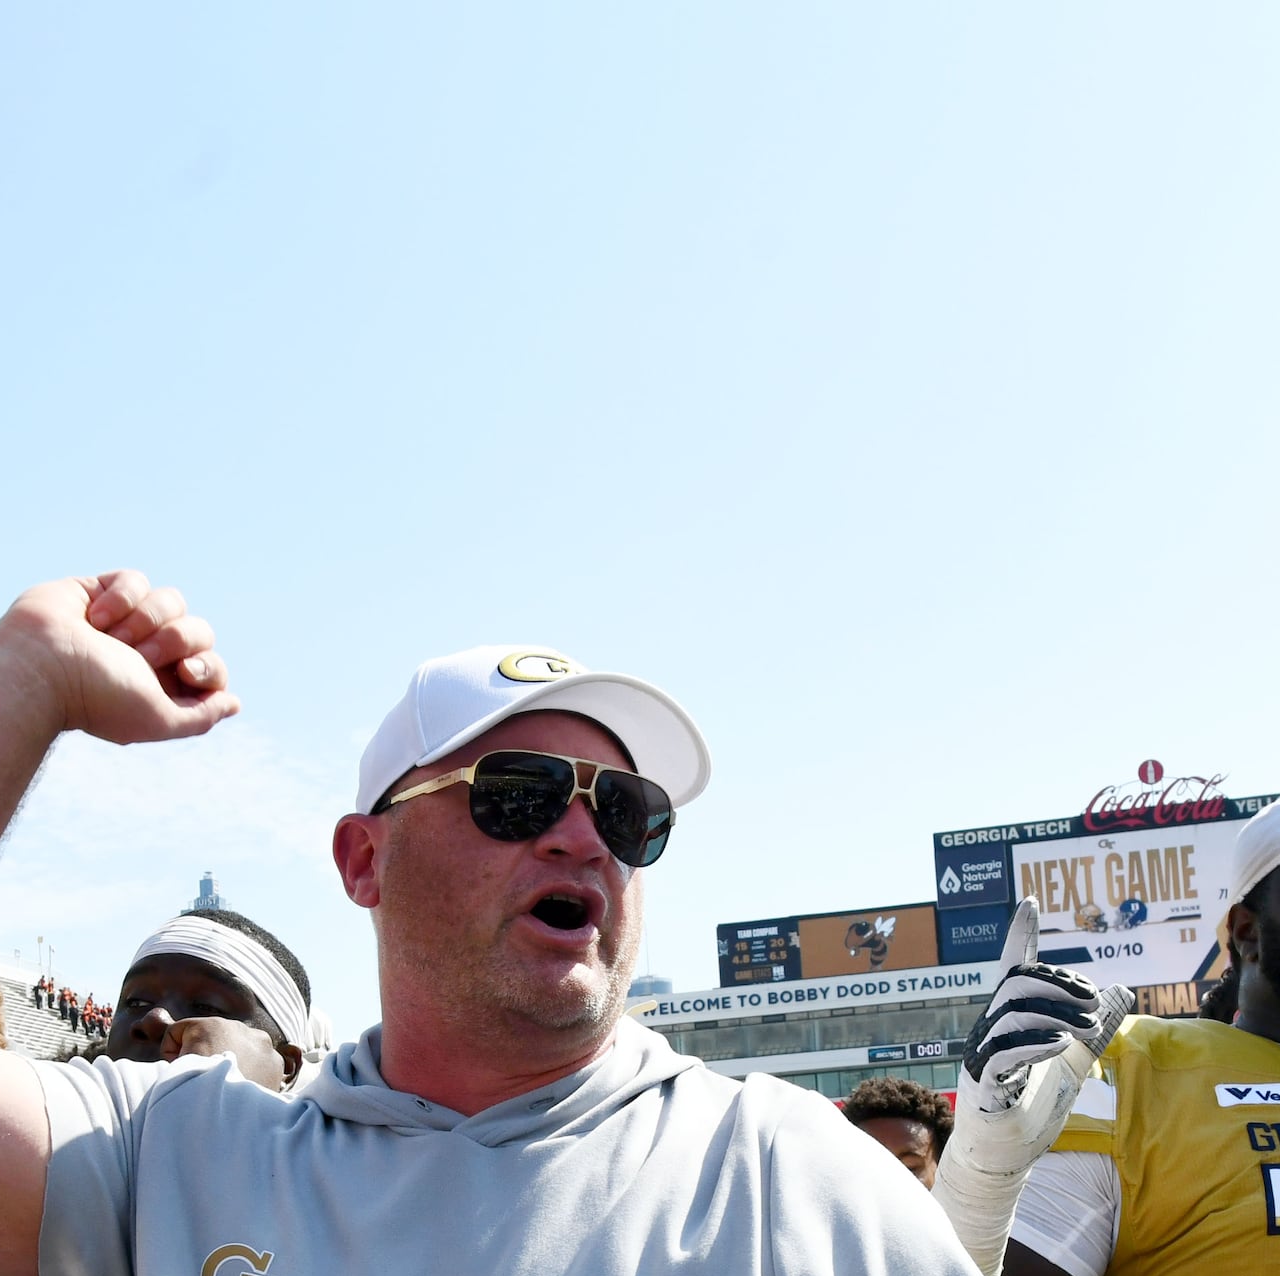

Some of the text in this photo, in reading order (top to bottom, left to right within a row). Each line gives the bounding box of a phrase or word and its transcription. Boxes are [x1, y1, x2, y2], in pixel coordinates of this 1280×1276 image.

[1083, 772, 1229, 832] Coca-Cola
[940, 820, 1071, 847] GEORGIA TECH
[962, 859, 1002, 873] Georgia
[963, 869, 1002, 883] Natural
[1021, 844, 1199, 916] NEXT GAME
[963, 881, 984, 892] Gas
[951, 923, 999, 939] EMORY
[1095, 942, 1144, 959] 10/10
[643, 972, 982, 1018] WELCOME TO BOBBY DODD STADIUM
[1138, 982, 1198, 1016] FINAL
[917, 1043, 942, 1057] 0:00
